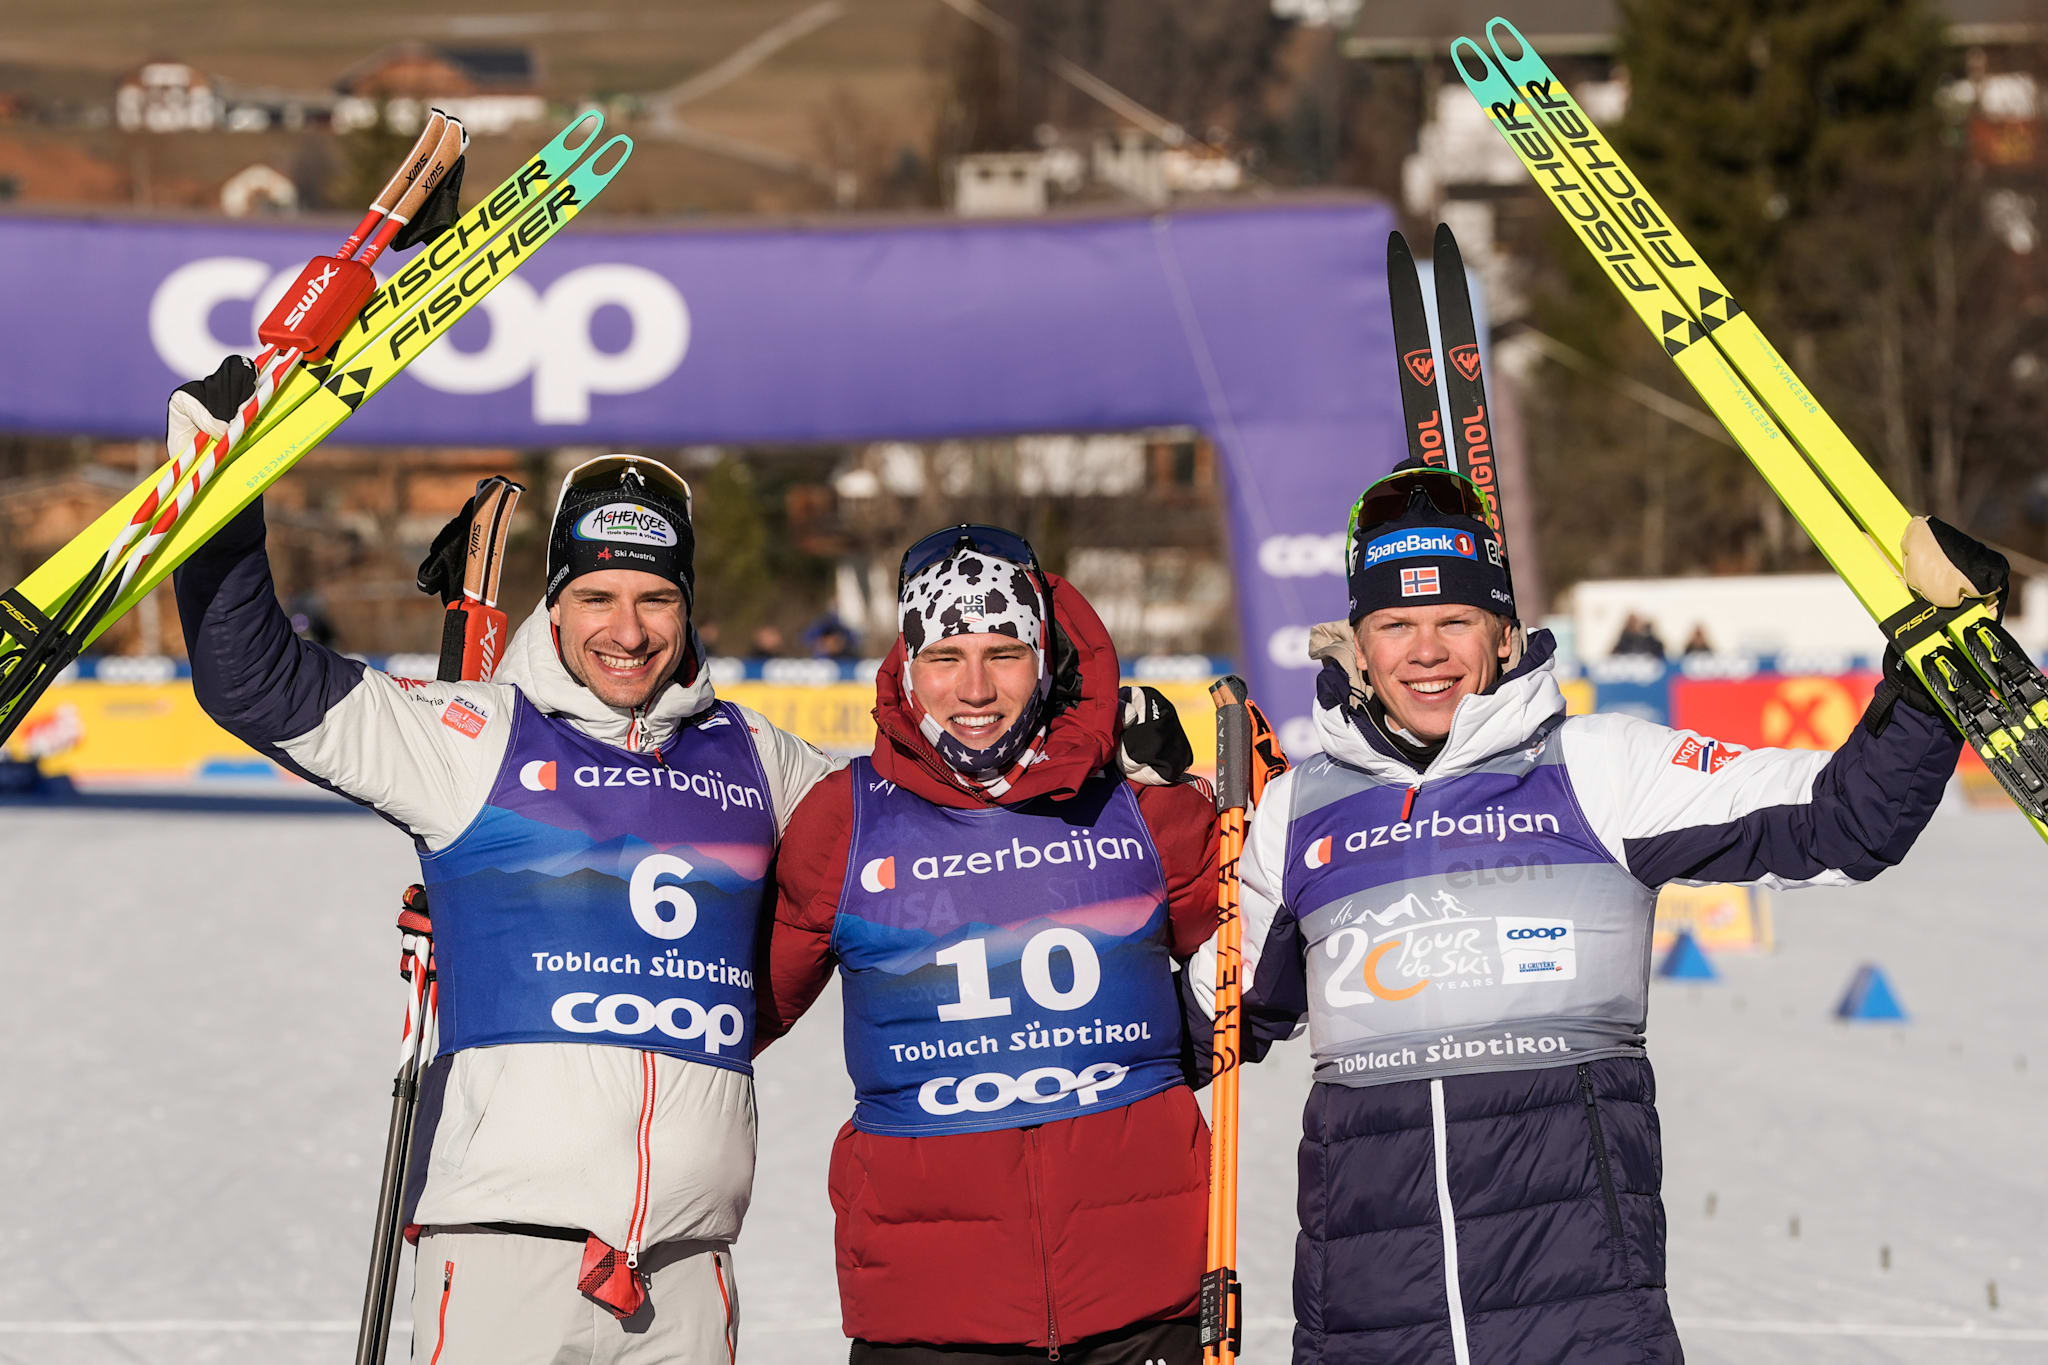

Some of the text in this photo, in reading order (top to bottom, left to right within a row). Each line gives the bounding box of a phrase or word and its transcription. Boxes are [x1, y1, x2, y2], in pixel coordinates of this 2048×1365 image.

[1491, 98, 1659, 293] FISCHER
[1526, 76, 1695, 271] FISCHER
[359, 158, 550, 333] FISCHER
[389, 183, 581, 361] FISCHER
[149, 257, 692, 425] cop
[614, 550, 656, 562] Ski Austria
[1366, 534, 1454, 563] SpareBank
[963, 594, 984, 605] US
[1675, 740, 1701, 764] NOR
[574, 764, 764, 812] azerbaijan
[1345, 805, 1560, 854] azerbaijan
[912, 829, 1144, 881] azerbaijan
[629, 853, 698, 940] 6
[1506, 926, 1567, 940] coop
[532, 951, 641, 976] Toblach
[935, 927, 1101, 1023] 10
[1436, 977, 1495, 991] YEARS
[551, 992, 745, 1053] coop
[889, 1036, 999, 1062] Toblach
[1333, 1047, 1417, 1075] Toblach
[918, 1062, 1131, 1116] coop
